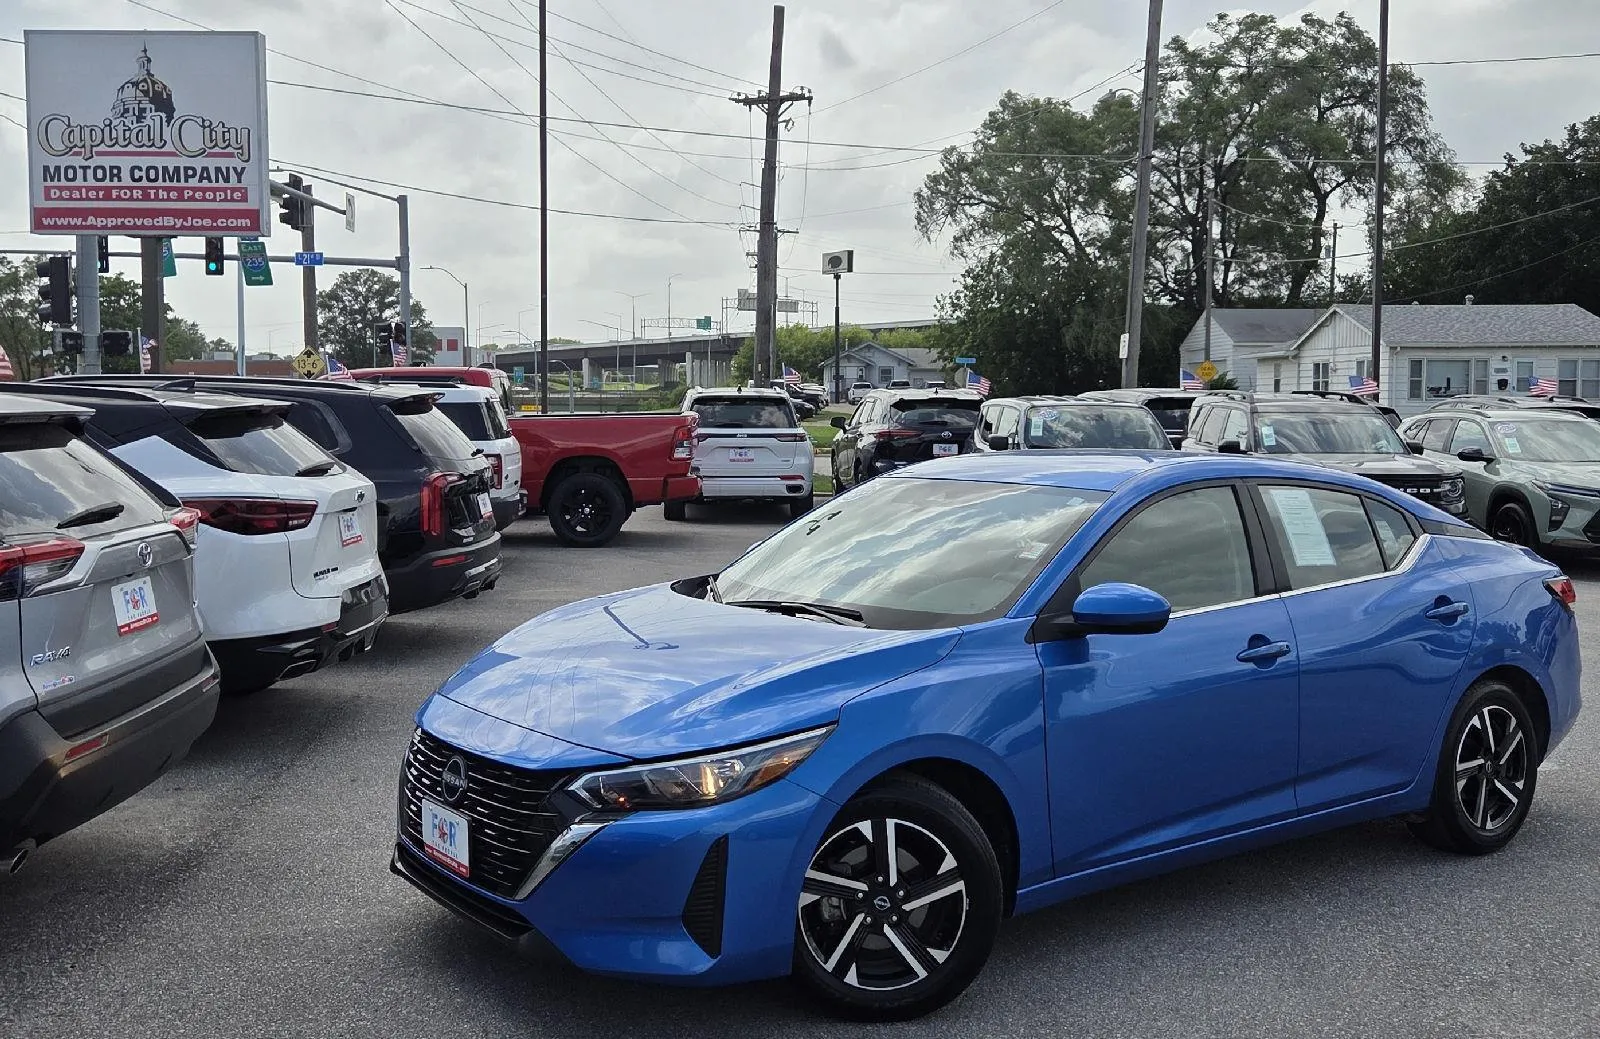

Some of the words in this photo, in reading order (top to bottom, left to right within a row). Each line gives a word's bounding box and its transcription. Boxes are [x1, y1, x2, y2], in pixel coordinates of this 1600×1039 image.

[37, 113, 167, 161] Capital
[171, 114, 251, 162] City
[43, 165, 122, 183] MOTOR
[129, 166, 246, 184] COMPANY
[50, 189, 104, 199] Dealer
[112, 189, 143, 199] FOR
[148, 190, 178, 199] The
[184, 190, 242, 201] People
[42, 215, 251, 227] www.ApprovedByJoe.com
[247, 257, 265, 267] 235
